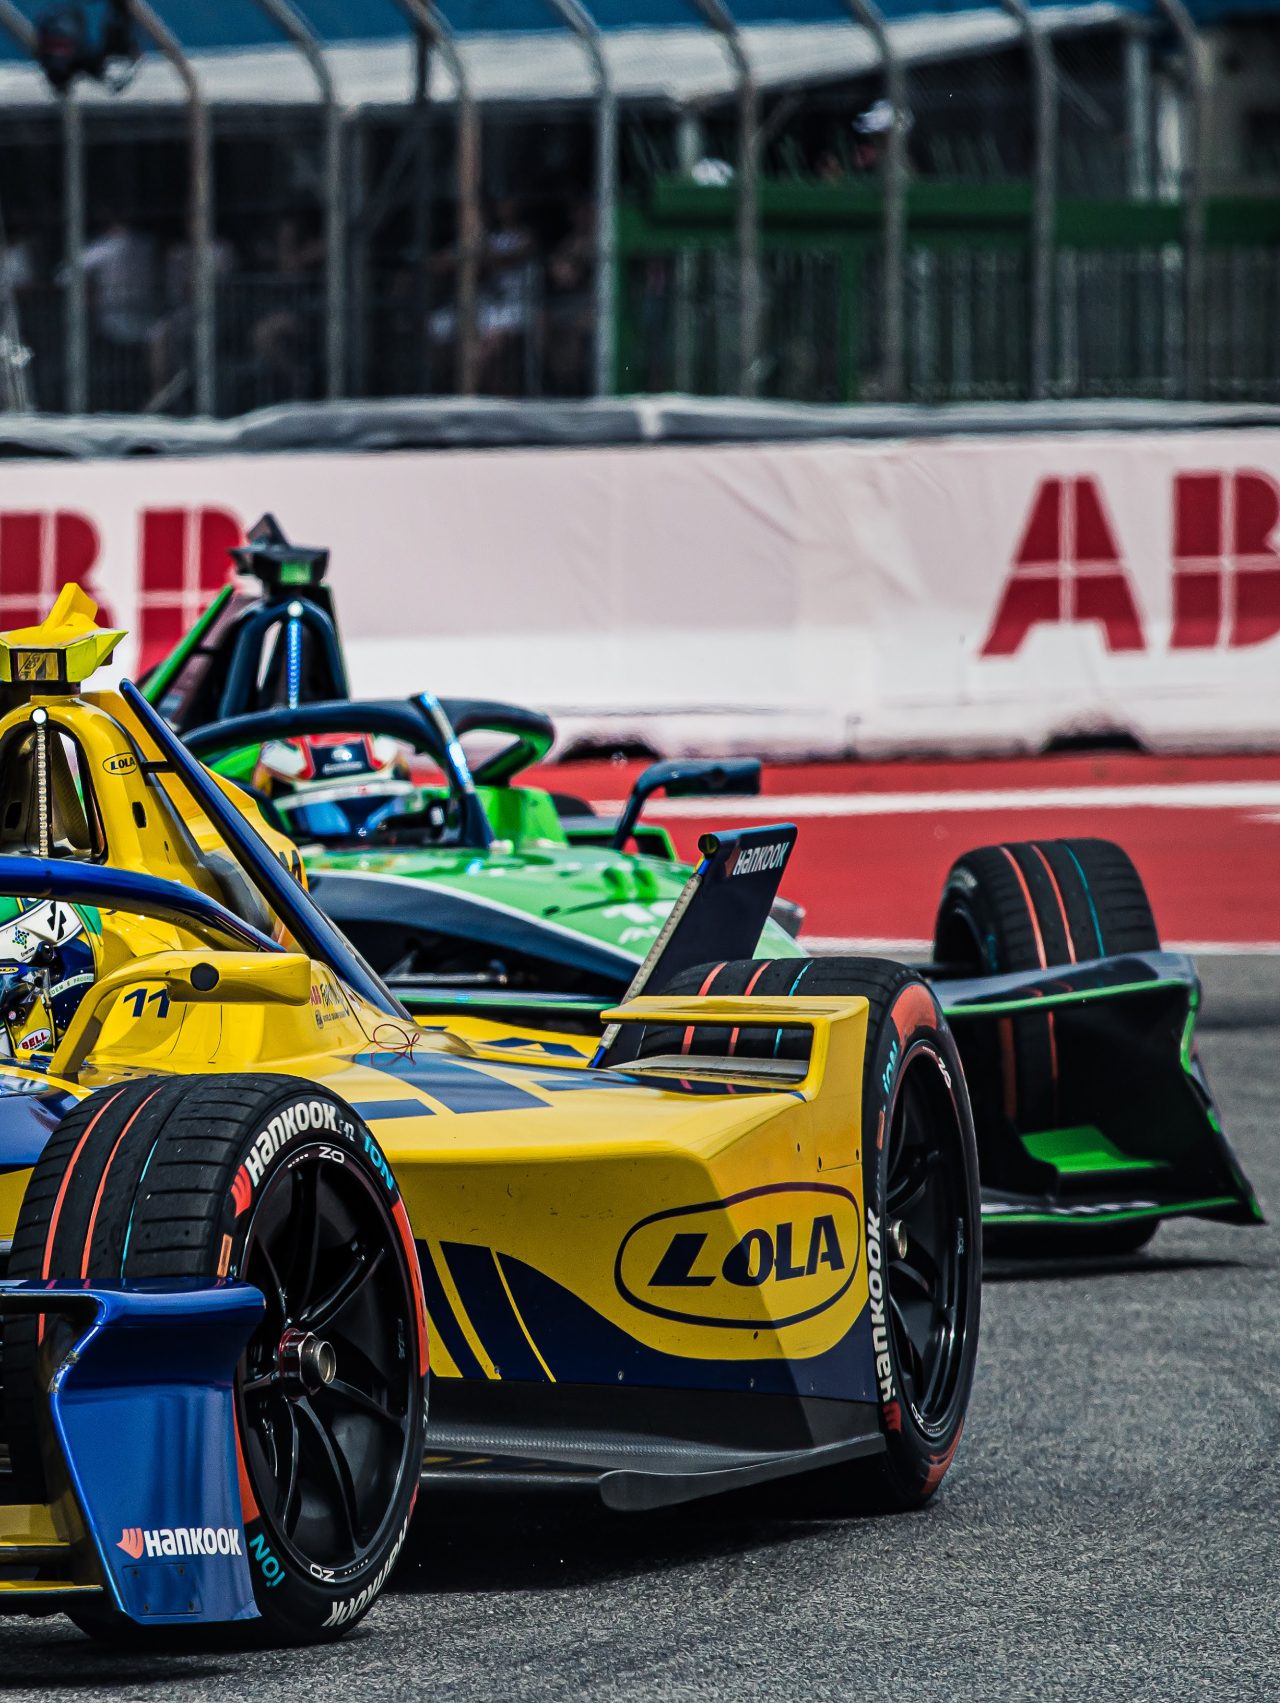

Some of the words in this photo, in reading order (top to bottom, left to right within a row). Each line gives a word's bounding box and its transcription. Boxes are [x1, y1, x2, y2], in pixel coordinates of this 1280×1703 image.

[110, 756, 136, 771] LOLA
[124, 988, 170, 1018] 11
[21, 1032, 47, 1050] BELL
[647, 1214, 846, 1288] LOLA
